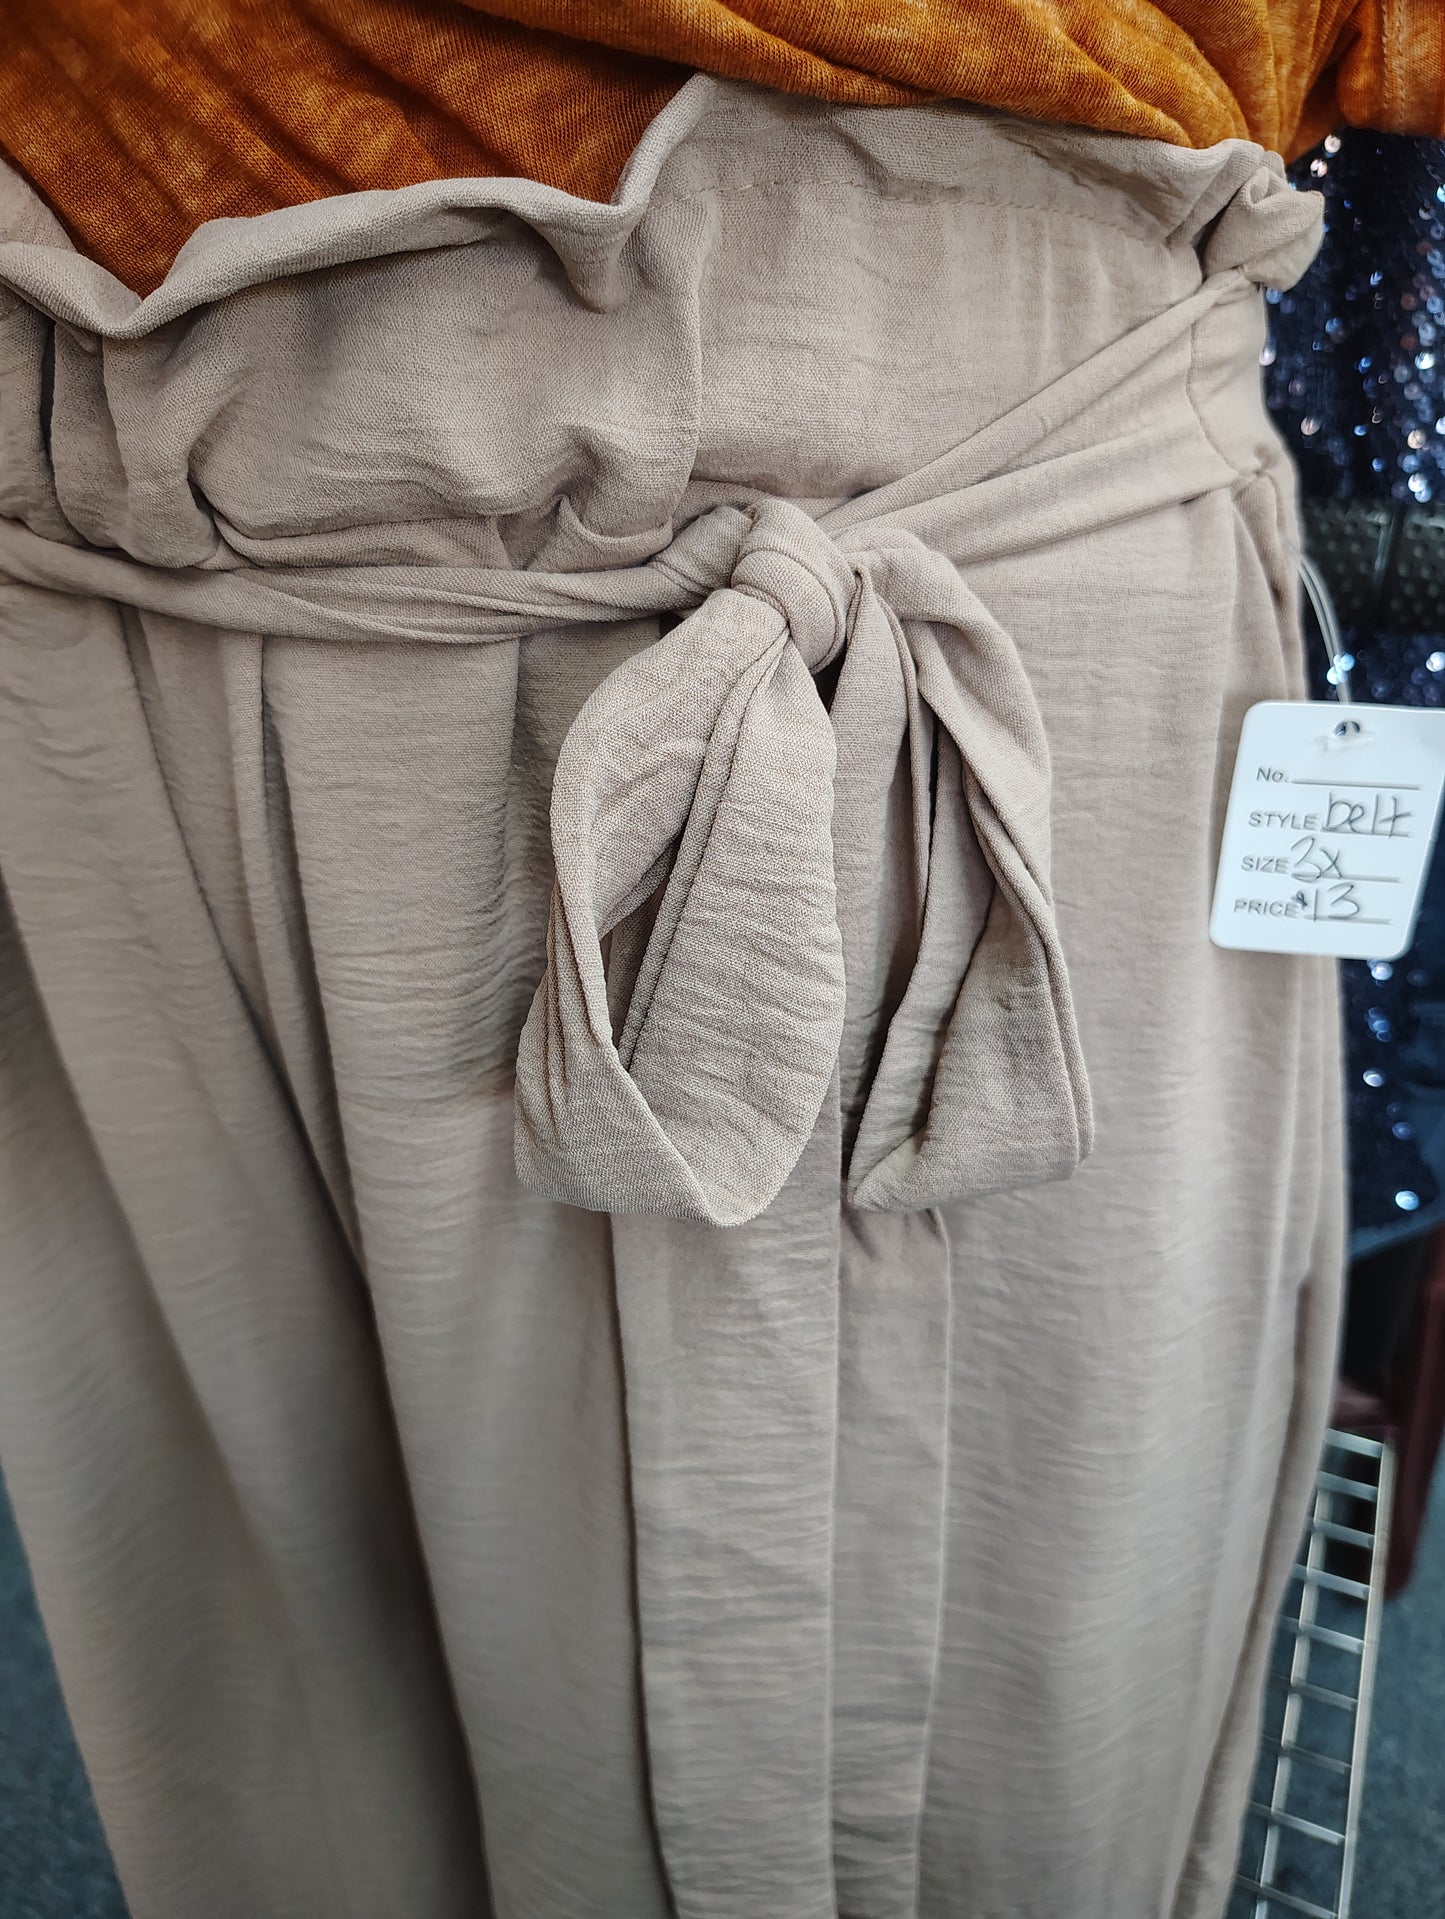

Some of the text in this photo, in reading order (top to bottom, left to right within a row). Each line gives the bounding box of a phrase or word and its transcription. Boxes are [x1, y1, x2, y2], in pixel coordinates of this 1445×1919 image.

[1256, 767, 1290, 784] No.
[1248, 792, 1412, 838] STYLE belt
[1240, 856, 1289, 875] SIZE
[1233, 899, 1300, 919] PRICE
